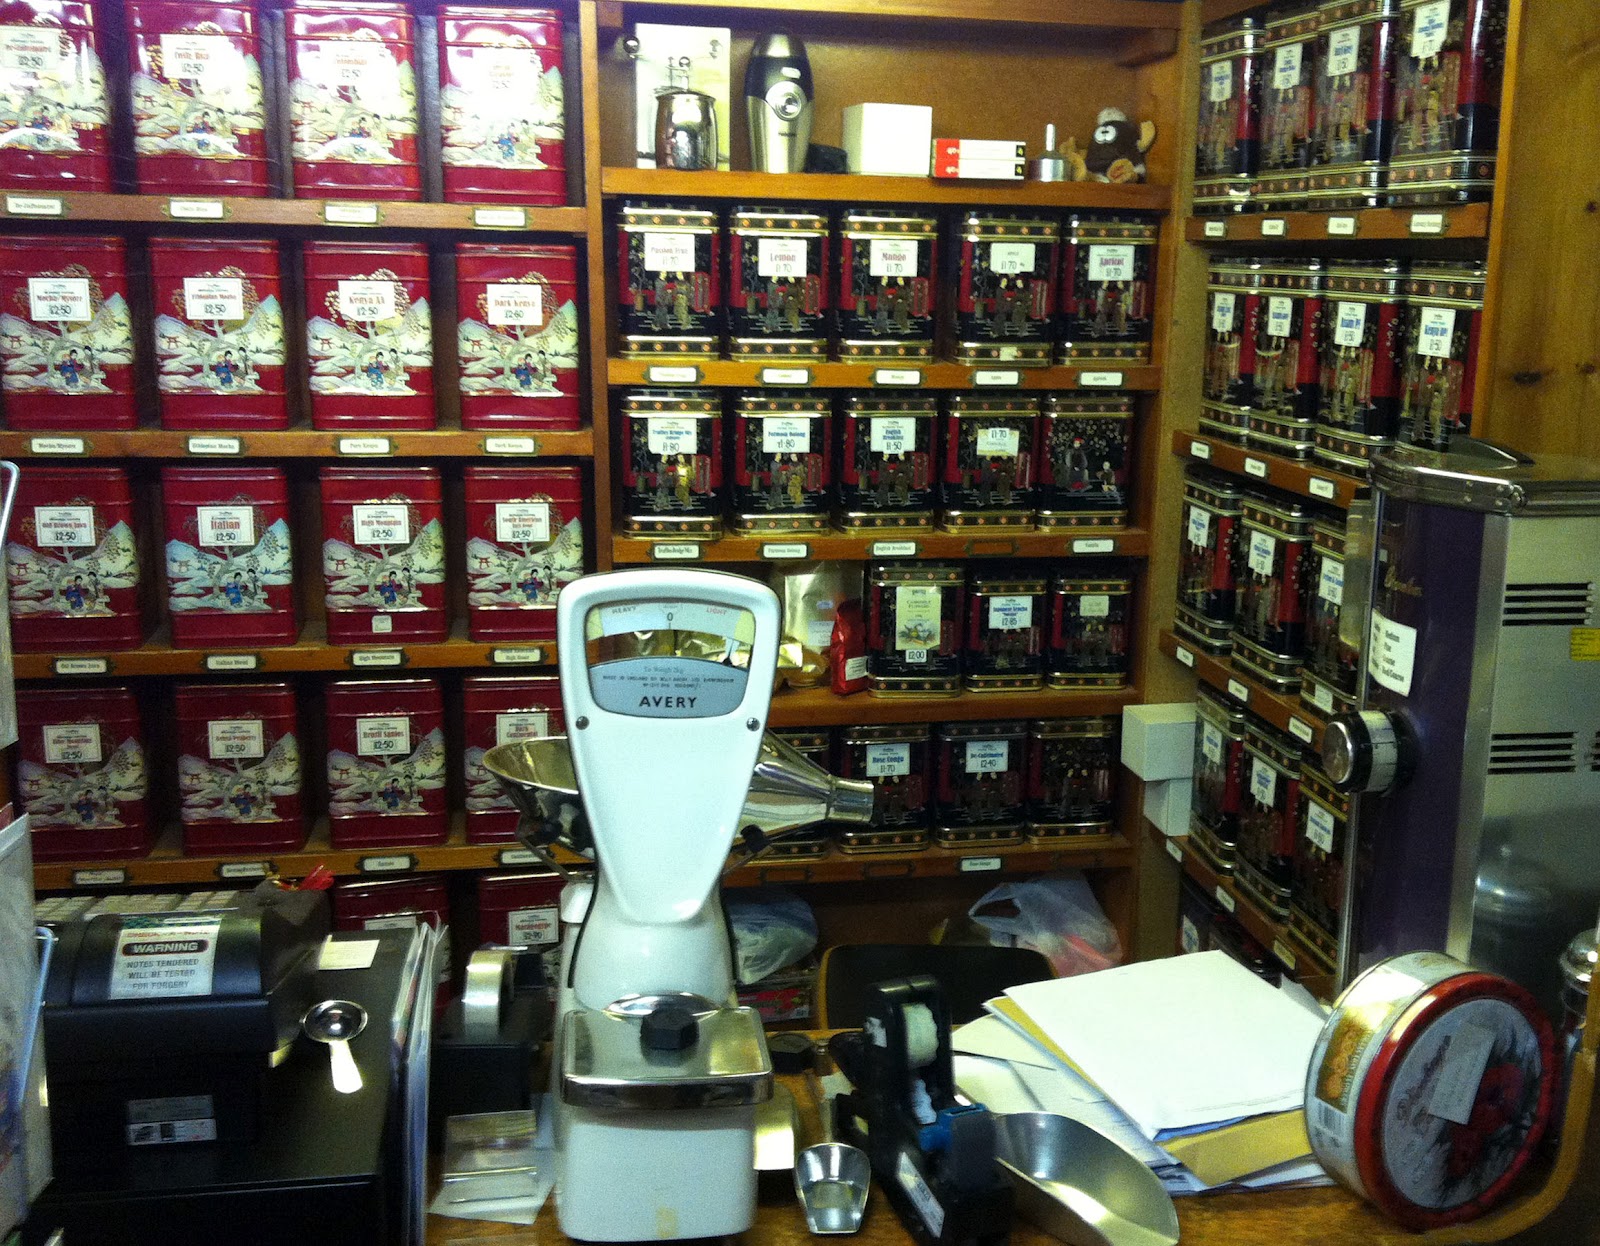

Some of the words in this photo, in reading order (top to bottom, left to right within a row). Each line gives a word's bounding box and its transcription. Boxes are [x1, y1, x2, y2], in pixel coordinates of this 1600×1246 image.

[770, 253, 796, 262] Lemon
[211, 520, 240, 530] Italian
[612, 606, 637, 614] HEAVY
[706, 607, 727, 616] LIGHT
[639, 696, 698, 708] AVERY
[383, 730, 404, 738] Santos
[133, 942, 198, 953] WARNING
[127, 961, 154, 969] NOTES
[157, 959, 199, 967] TENDERED
[152, 971, 162, 979] BE
[164, 970, 196, 978] TESTED
[151, 981, 190, 989] FORGERY
